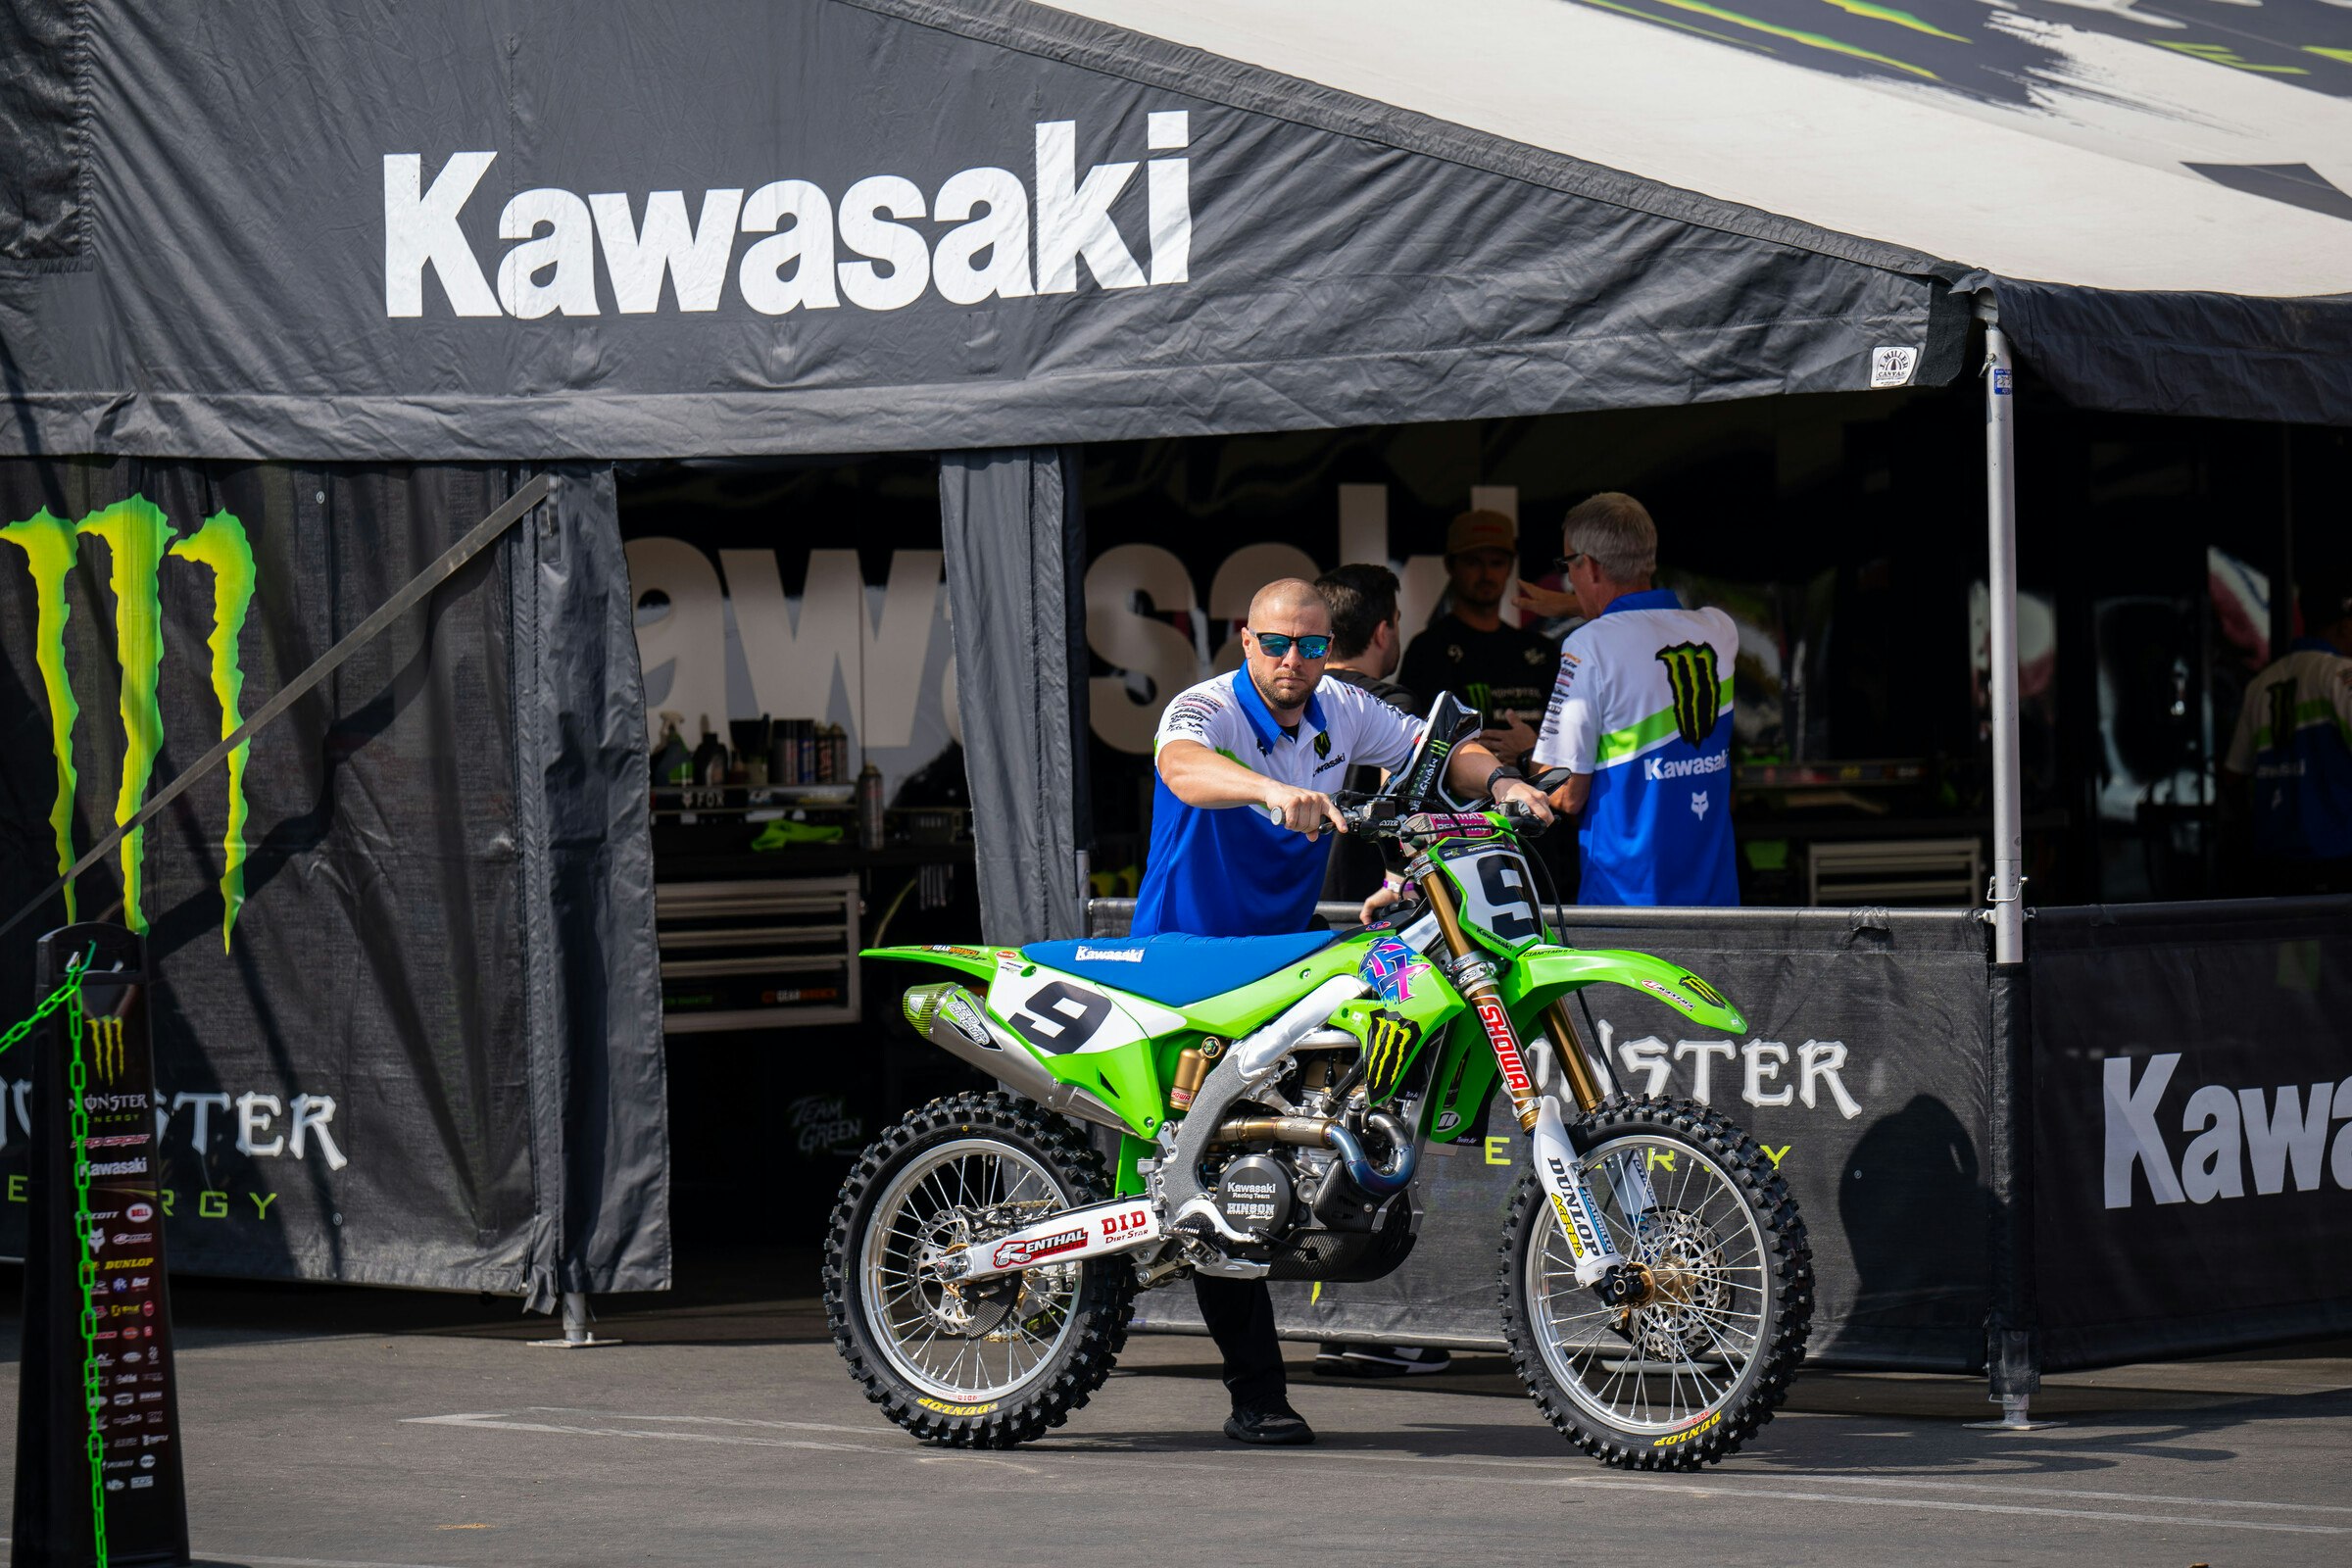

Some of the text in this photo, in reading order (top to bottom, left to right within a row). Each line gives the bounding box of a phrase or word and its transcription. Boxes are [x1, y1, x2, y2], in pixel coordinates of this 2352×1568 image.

[383, 110, 1191, 319] Kawasaki
[1884, 350, 1909, 368] MILLER
[1313, 752, 1346, 777] wasaki
[1643, 749, 1730, 781] Kawasak
[696, 790, 725, 807] FOX
[1476, 927, 1514, 952] Kawasaki
[1075, 945, 1146, 963] Kawasaki
[1006, 980, 1112, 1056] 9
[1477, 1004, 1531, 1092] SHOWA
[87, 1113, 139, 1123] NERGY
[787, 1094, 843, 1128] TEAM
[799, 1117, 863, 1154] GREEN
[1227, 1182, 1277, 1194] Kawasaki
[1227, 1202, 1275, 1215] HINSON
[1547, 1157, 1601, 1257] DUNLOP
[1101, 1210, 1147, 1236] D.I.D
[1586, 1193, 1614, 1252] CARRILLO
[995, 1228, 1088, 1267] RENTHAL
[103, 1256, 154, 1270] DUNLOP
[916, 1396, 992, 1416] DUNLOP
[1652, 1409, 1722, 1447] DUNLOP
